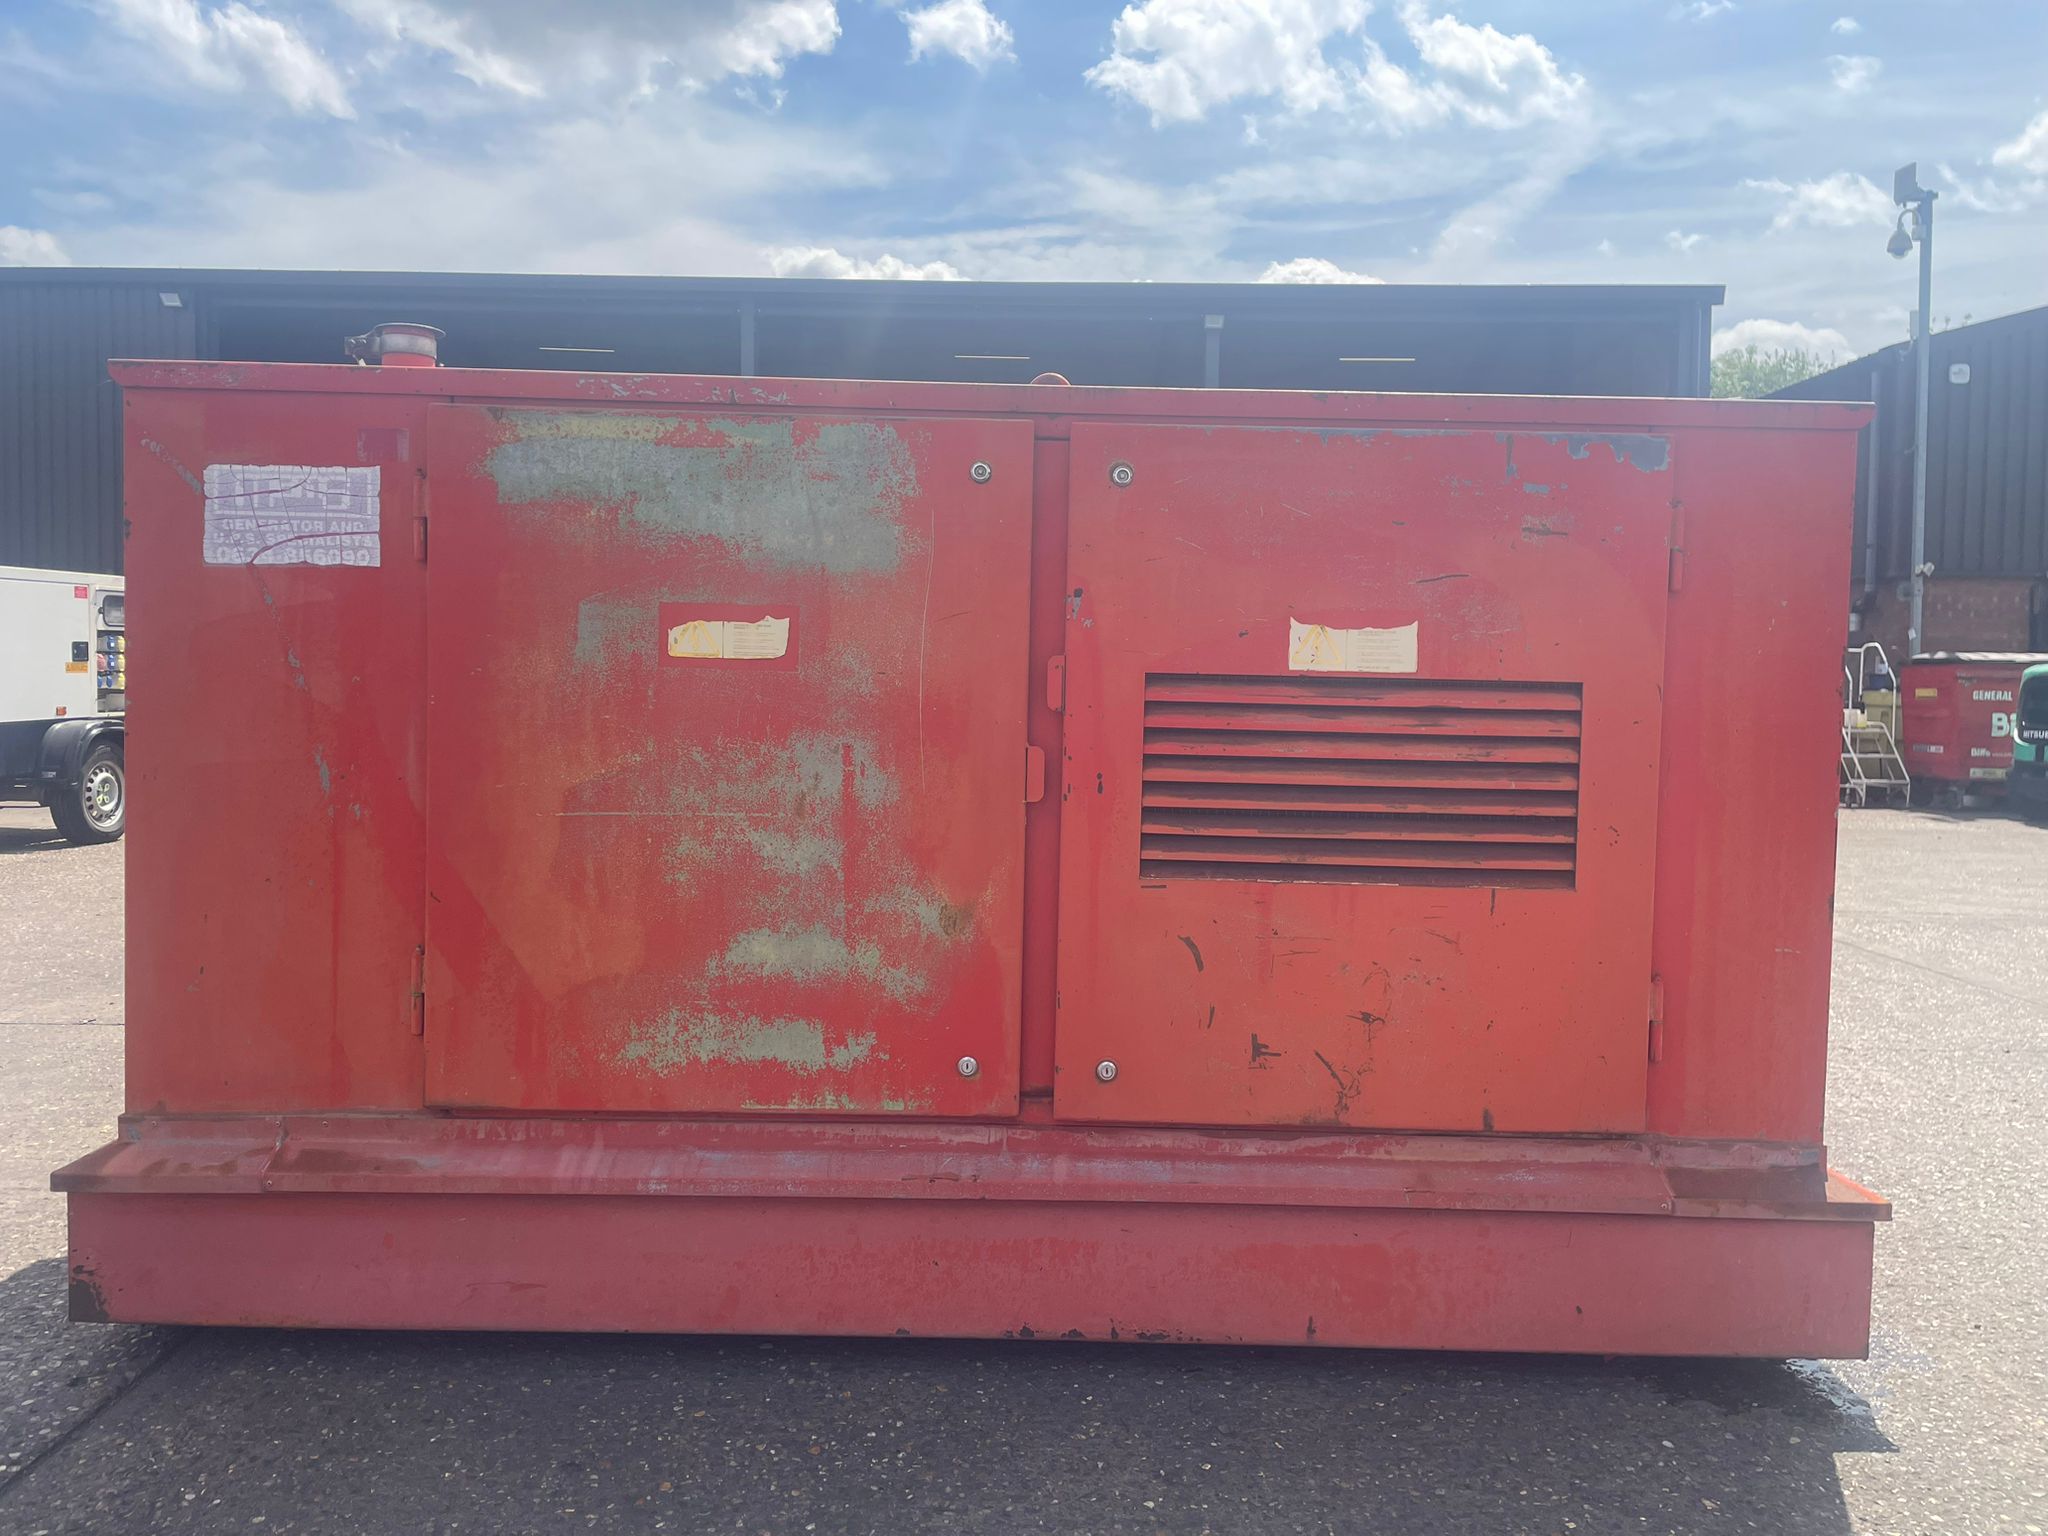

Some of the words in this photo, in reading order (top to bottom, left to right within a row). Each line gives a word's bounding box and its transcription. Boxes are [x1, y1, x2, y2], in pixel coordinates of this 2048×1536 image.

[222, 518, 324, 532] GENERATOR
[329, 520, 364, 533] AND
[1973, 690, 2013, 701] GENERAL
